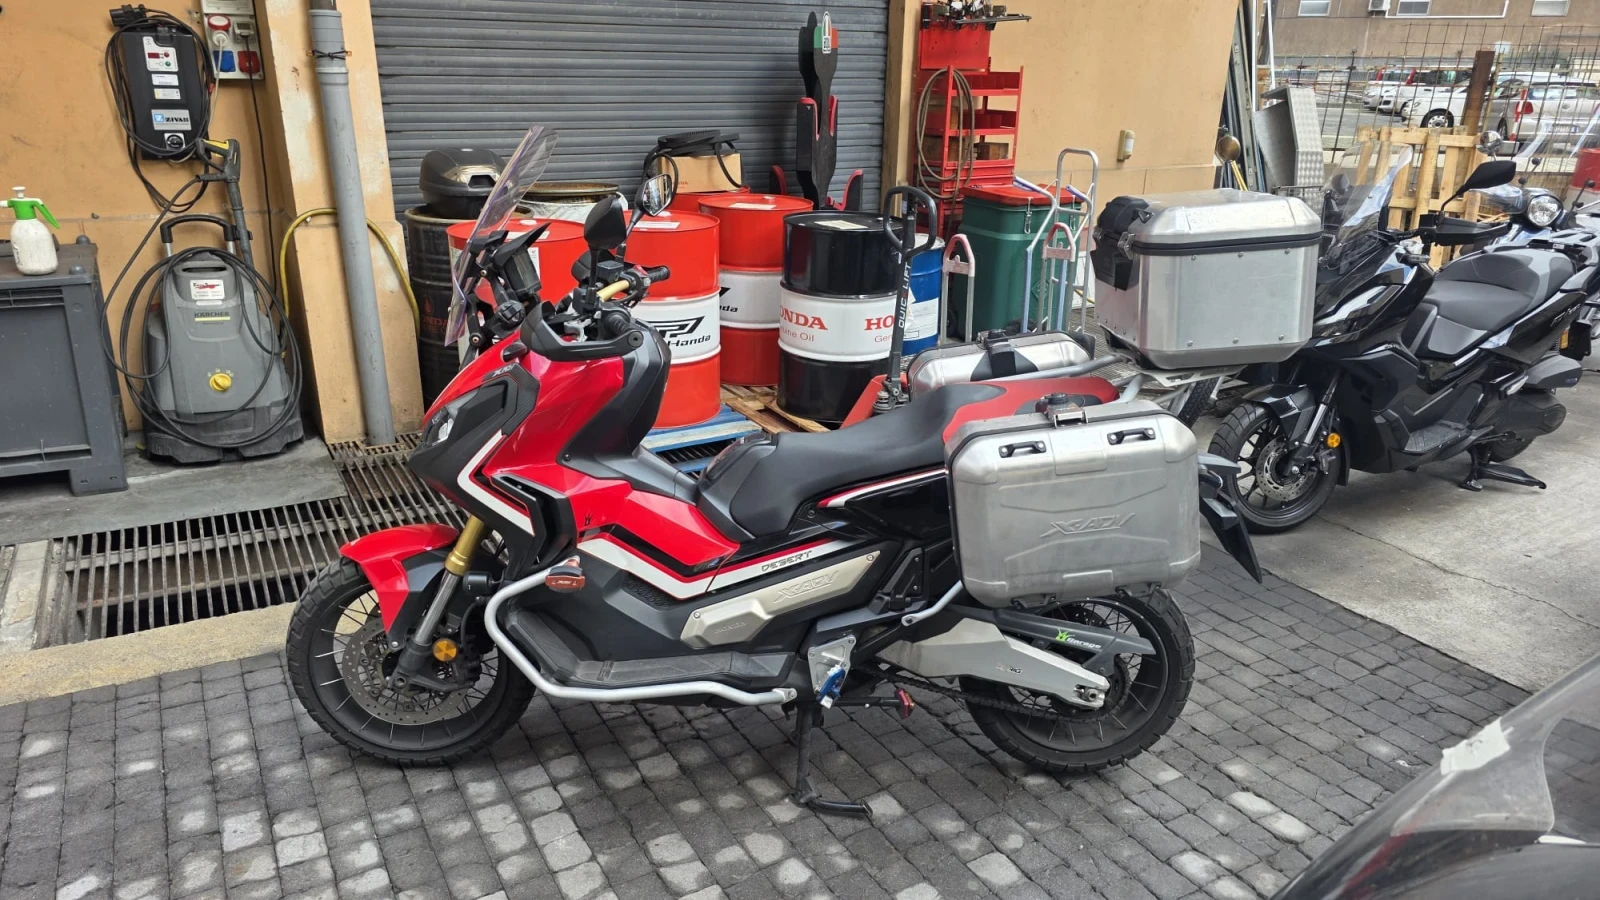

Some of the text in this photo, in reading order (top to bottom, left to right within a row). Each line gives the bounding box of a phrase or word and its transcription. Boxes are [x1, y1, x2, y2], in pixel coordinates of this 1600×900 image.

[779, 305, 829, 331] ONDA
[799, 332, 815, 342] Oil
[761, 550, 813, 572] DESERT
